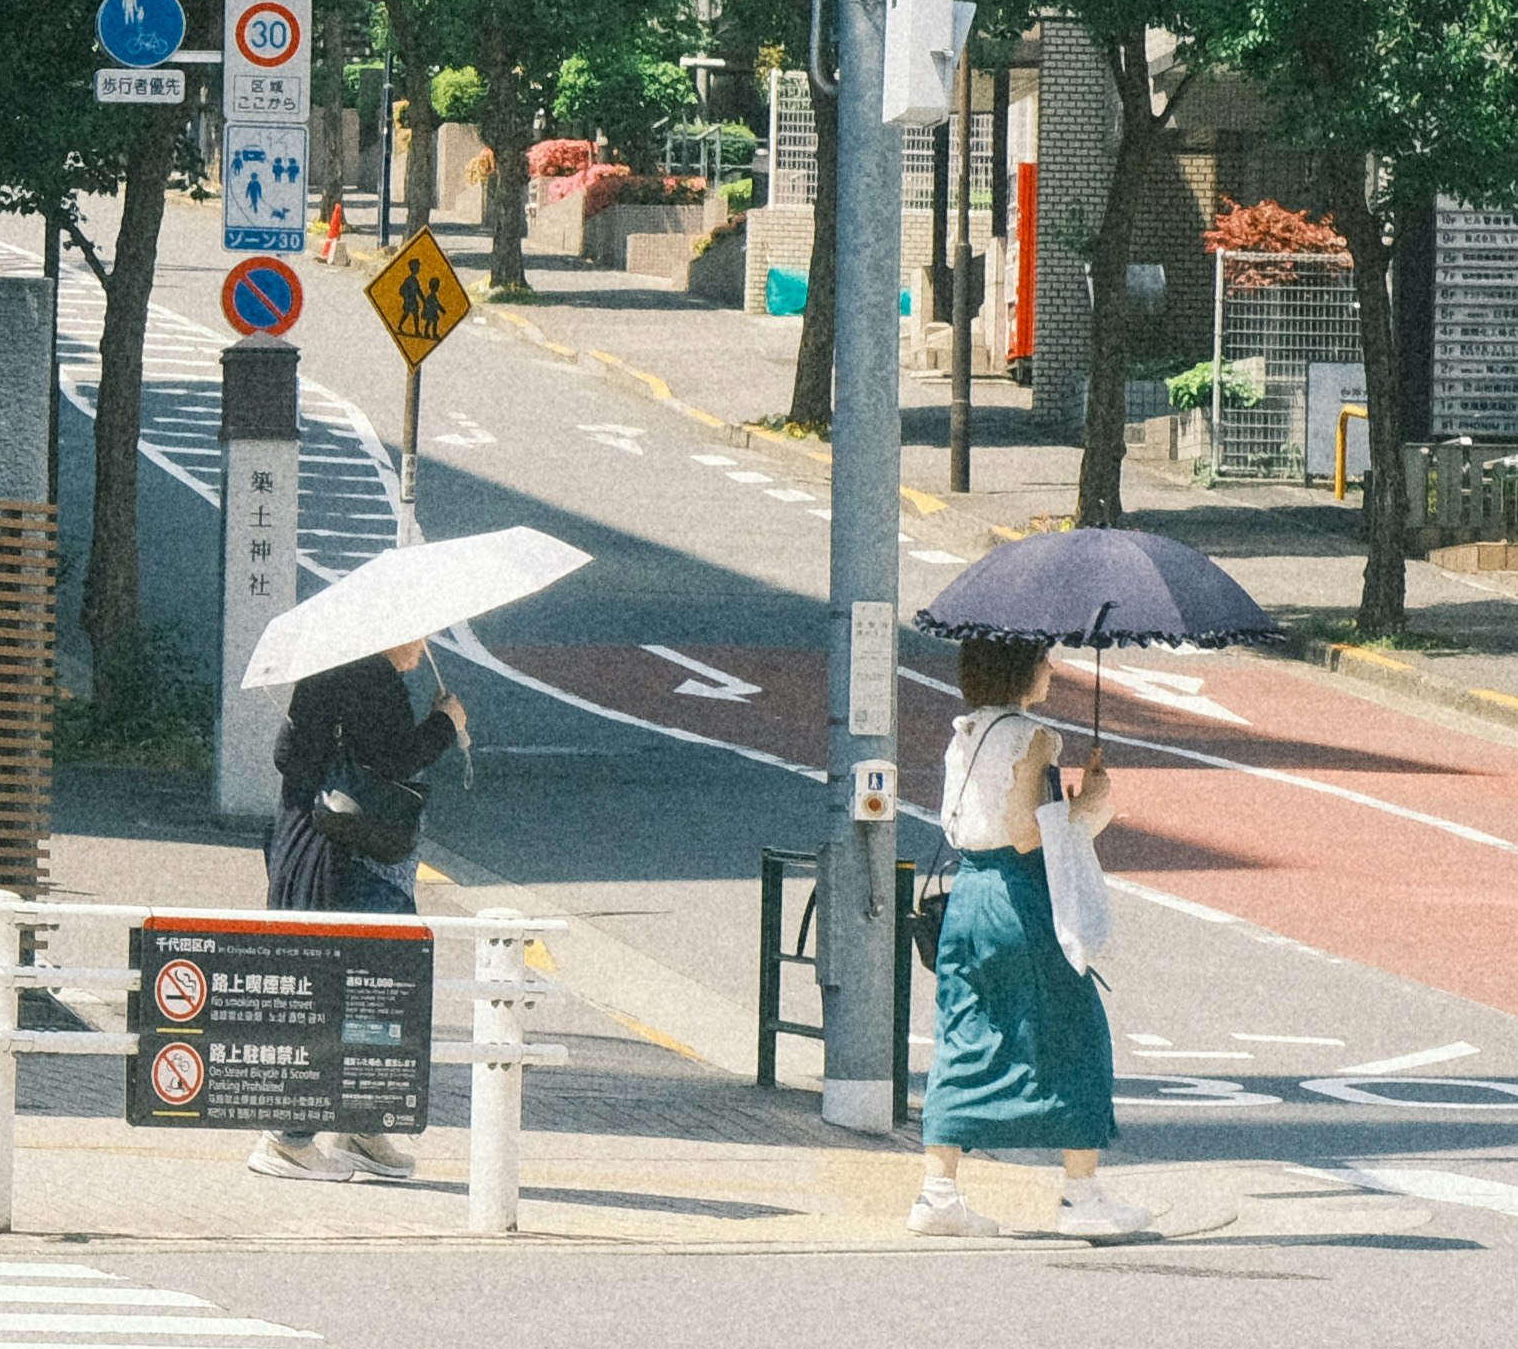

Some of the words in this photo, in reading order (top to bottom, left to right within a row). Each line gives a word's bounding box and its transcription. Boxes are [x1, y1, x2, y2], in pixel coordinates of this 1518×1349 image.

[251, 20, 287, 49] 30
[101, 77, 182, 96] 歩行者優先
[250, 79, 284, 95] 区域
[237, 96, 297, 111] ここから
[227, 233, 302, 249] ゾーン30
[248, 470, 274, 596] 築土神社
[155, 936, 216, 954] 千代田区内
[210, 972, 314, 996] 路上喫煙禁止
[210, 995, 224, 1008] No
[224, 997, 260, 1010] smoking
[261, 999, 273, 1009] on
[273, 997, 288, 1010] the
[288, 999, 313, 1011] street
[208, 1042, 311, 1066] 路上駐輪禁止
[208, 1066, 248, 1079] On-Street
[289, 1069, 321, 1081] Scooter
[208, 1079, 241, 1094] Parking
[242, 1081, 285, 1093] Prohibited
